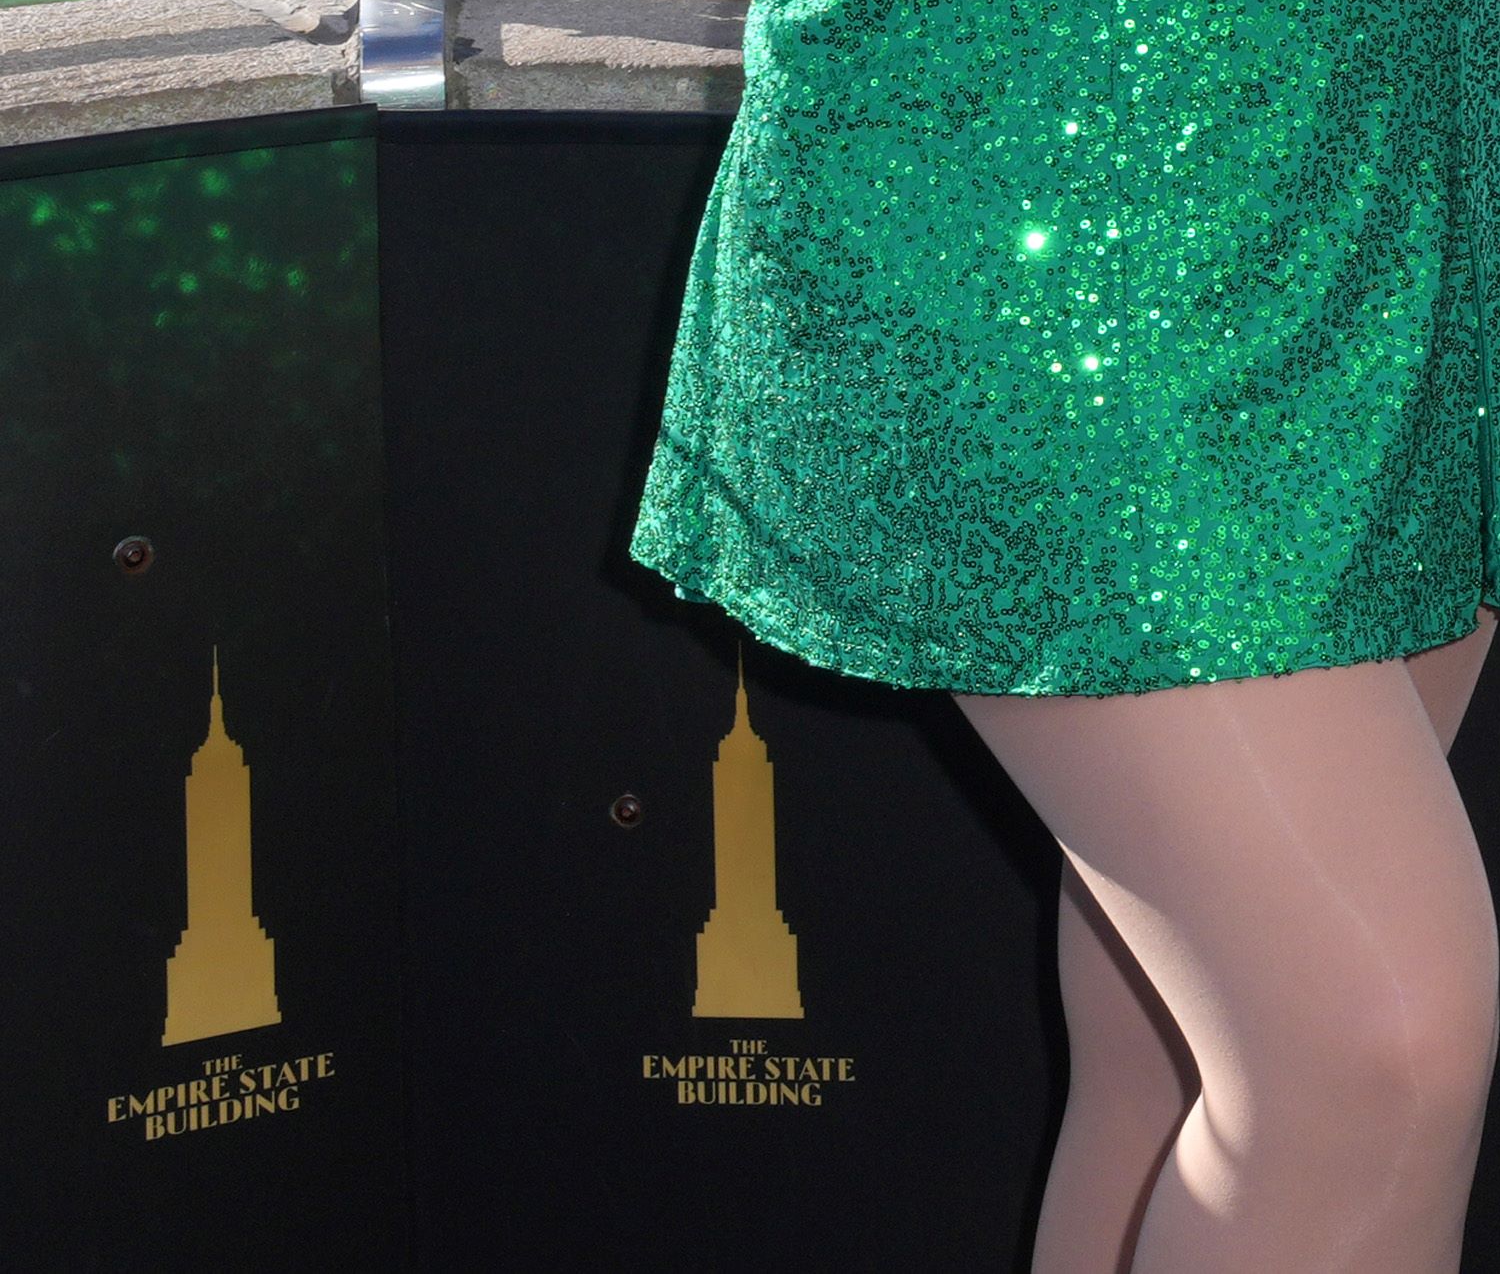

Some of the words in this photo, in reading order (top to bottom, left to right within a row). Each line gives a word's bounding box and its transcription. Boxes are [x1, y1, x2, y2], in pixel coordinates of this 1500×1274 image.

[729, 1039, 768, 1055] THE
[202, 1054, 243, 1076] THE
[642, 1055, 756, 1080] EMPIRE
[764, 1057, 856, 1082] STATE
[107, 1074, 230, 1123] EMPIRE
[239, 1052, 335, 1095] STATE
[677, 1081, 822, 1106] BUILDING
[146, 1085, 300, 1141] BUILDING
